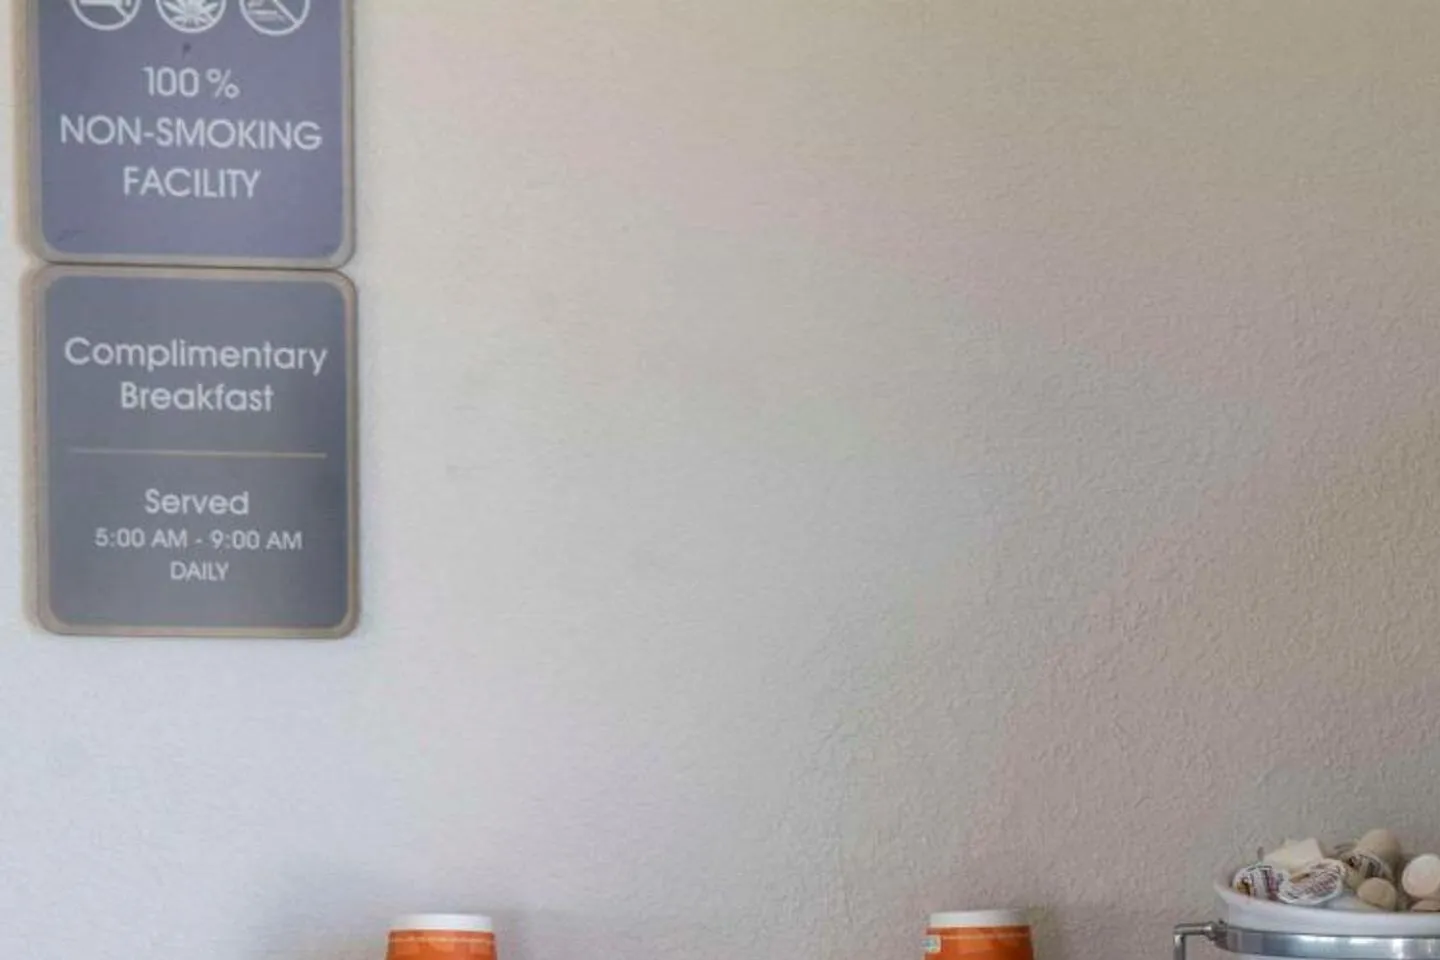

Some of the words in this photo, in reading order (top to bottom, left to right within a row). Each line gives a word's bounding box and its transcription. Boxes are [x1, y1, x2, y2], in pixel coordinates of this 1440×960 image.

[143, 66, 200, 97] 100
[205, 68, 240, 99] %
[60, 115, 323, 151] NON-SMOKING
[124, 166, 261, 198] FACILITY
[64, 336, 328, 376] Complimentary
[120, 381, 274, 412] Breakfast
[144, 488, 249, 515] Served
[95, 527, 145, 548] 5:00
[151, 529, 188, 548] AM
[211, 530, 260, 549] 9:00
[266, 531, 303, 550] AM
[170, 561, 229, 581] DAILY
